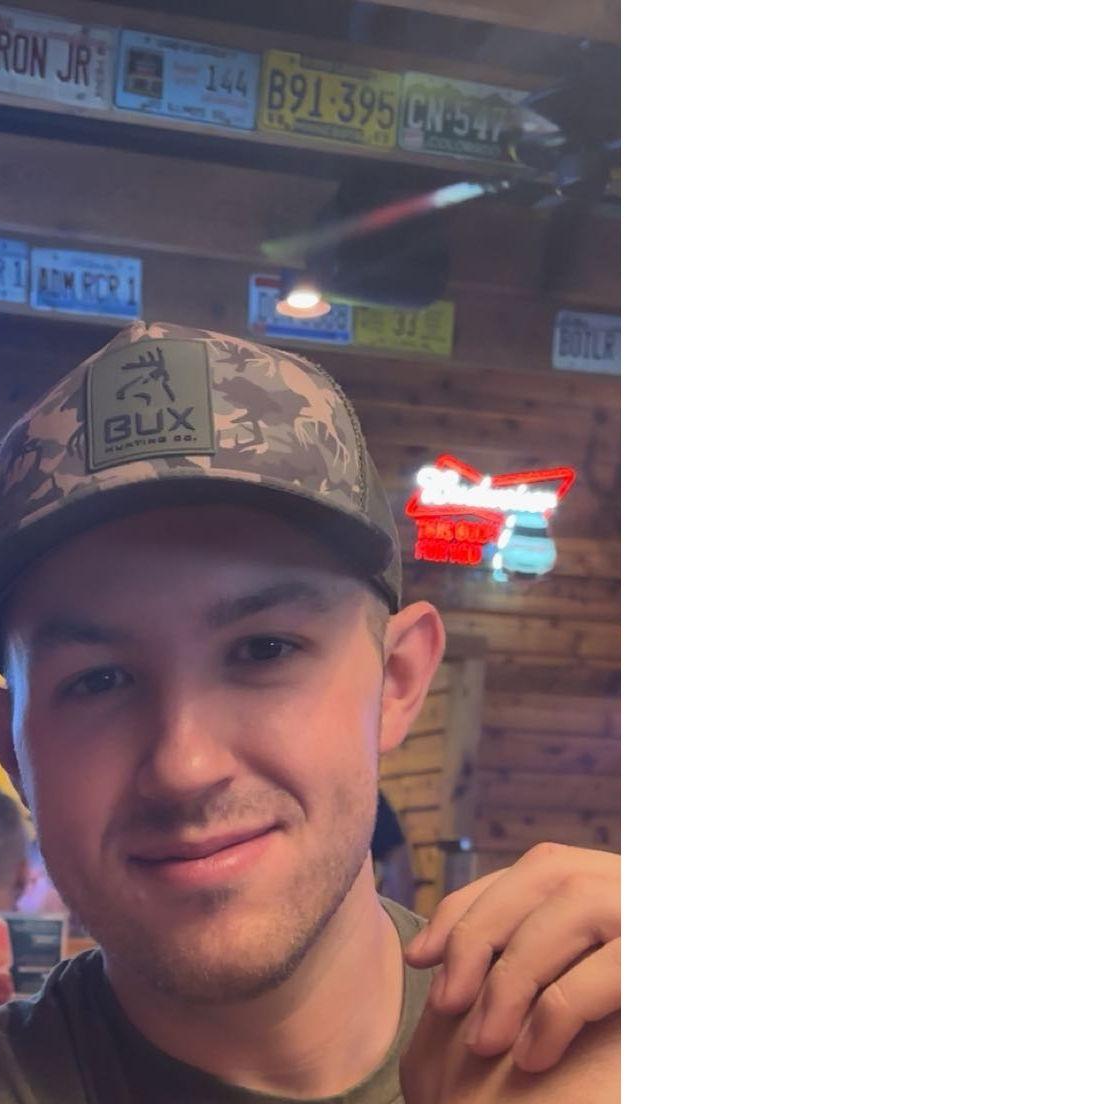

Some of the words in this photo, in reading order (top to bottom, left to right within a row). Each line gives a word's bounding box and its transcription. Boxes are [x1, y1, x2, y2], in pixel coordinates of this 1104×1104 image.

[56, 40, 92, 87] JR
[205, 64, 248, 97] 144
[104, 406, 196, 443] BUX
[105, 436, 167, 453] HUNTING
[173, 434, 198, 442] CO.
